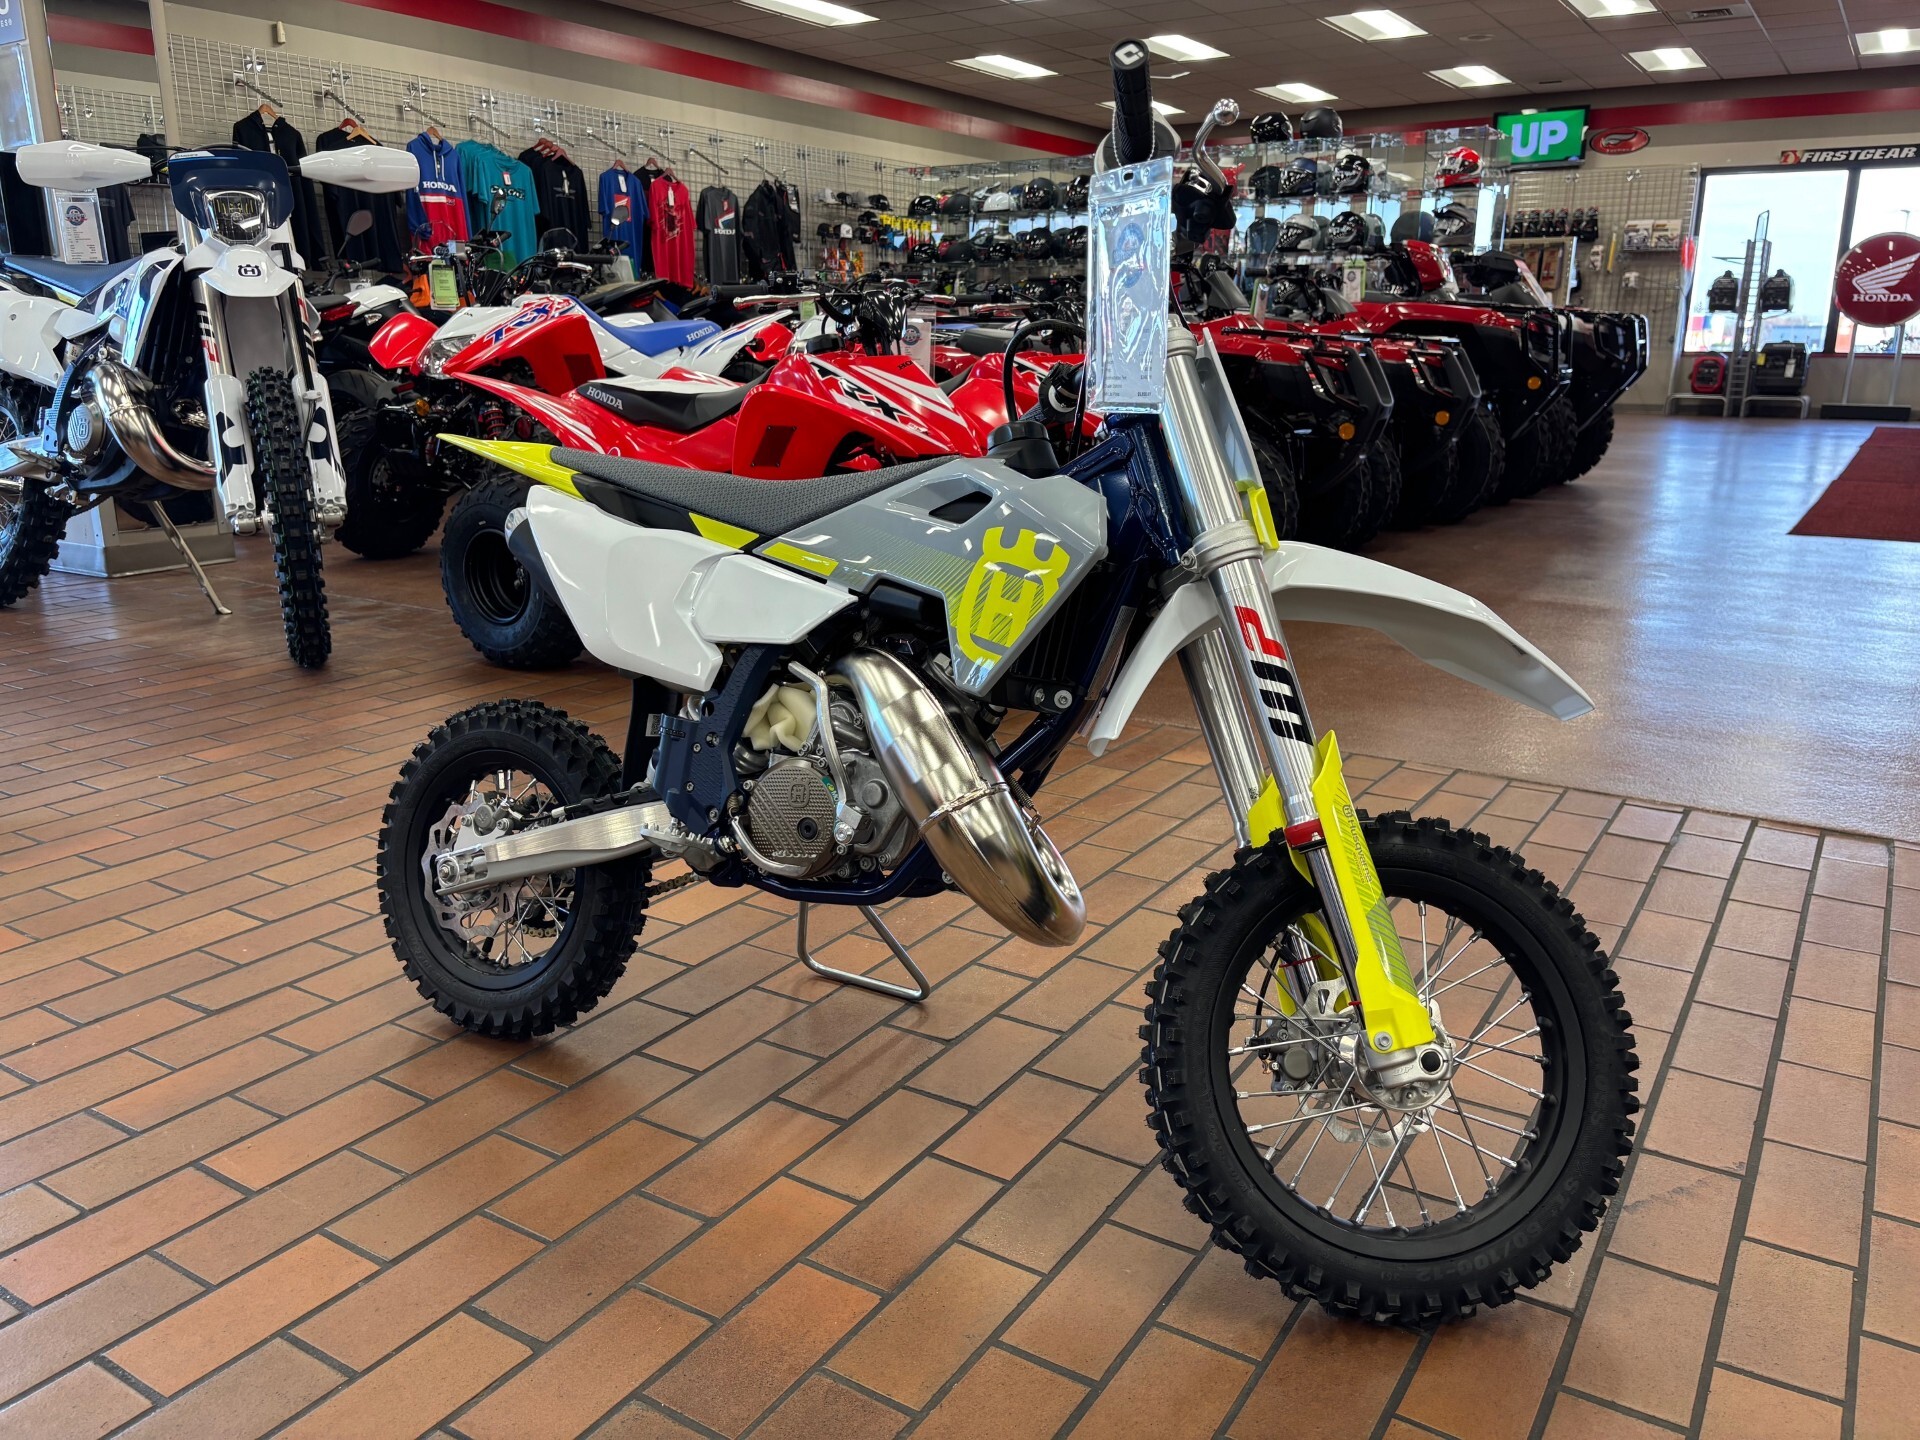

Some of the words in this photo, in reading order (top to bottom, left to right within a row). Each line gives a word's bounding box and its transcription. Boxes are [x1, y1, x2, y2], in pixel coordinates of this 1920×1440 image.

[1511, 120, 1568, 157] UP
[1801, 147, 1917, 163] FIRSTGEAR
[422, 181, 457, 193] HONDA
[1852, 293, 1914, 303] HONDA
[686, 325, 716, 342] HONDA
[586, 386, 624, 411] HONDA
[1348, 819, 1373, 883] Husqvarna
